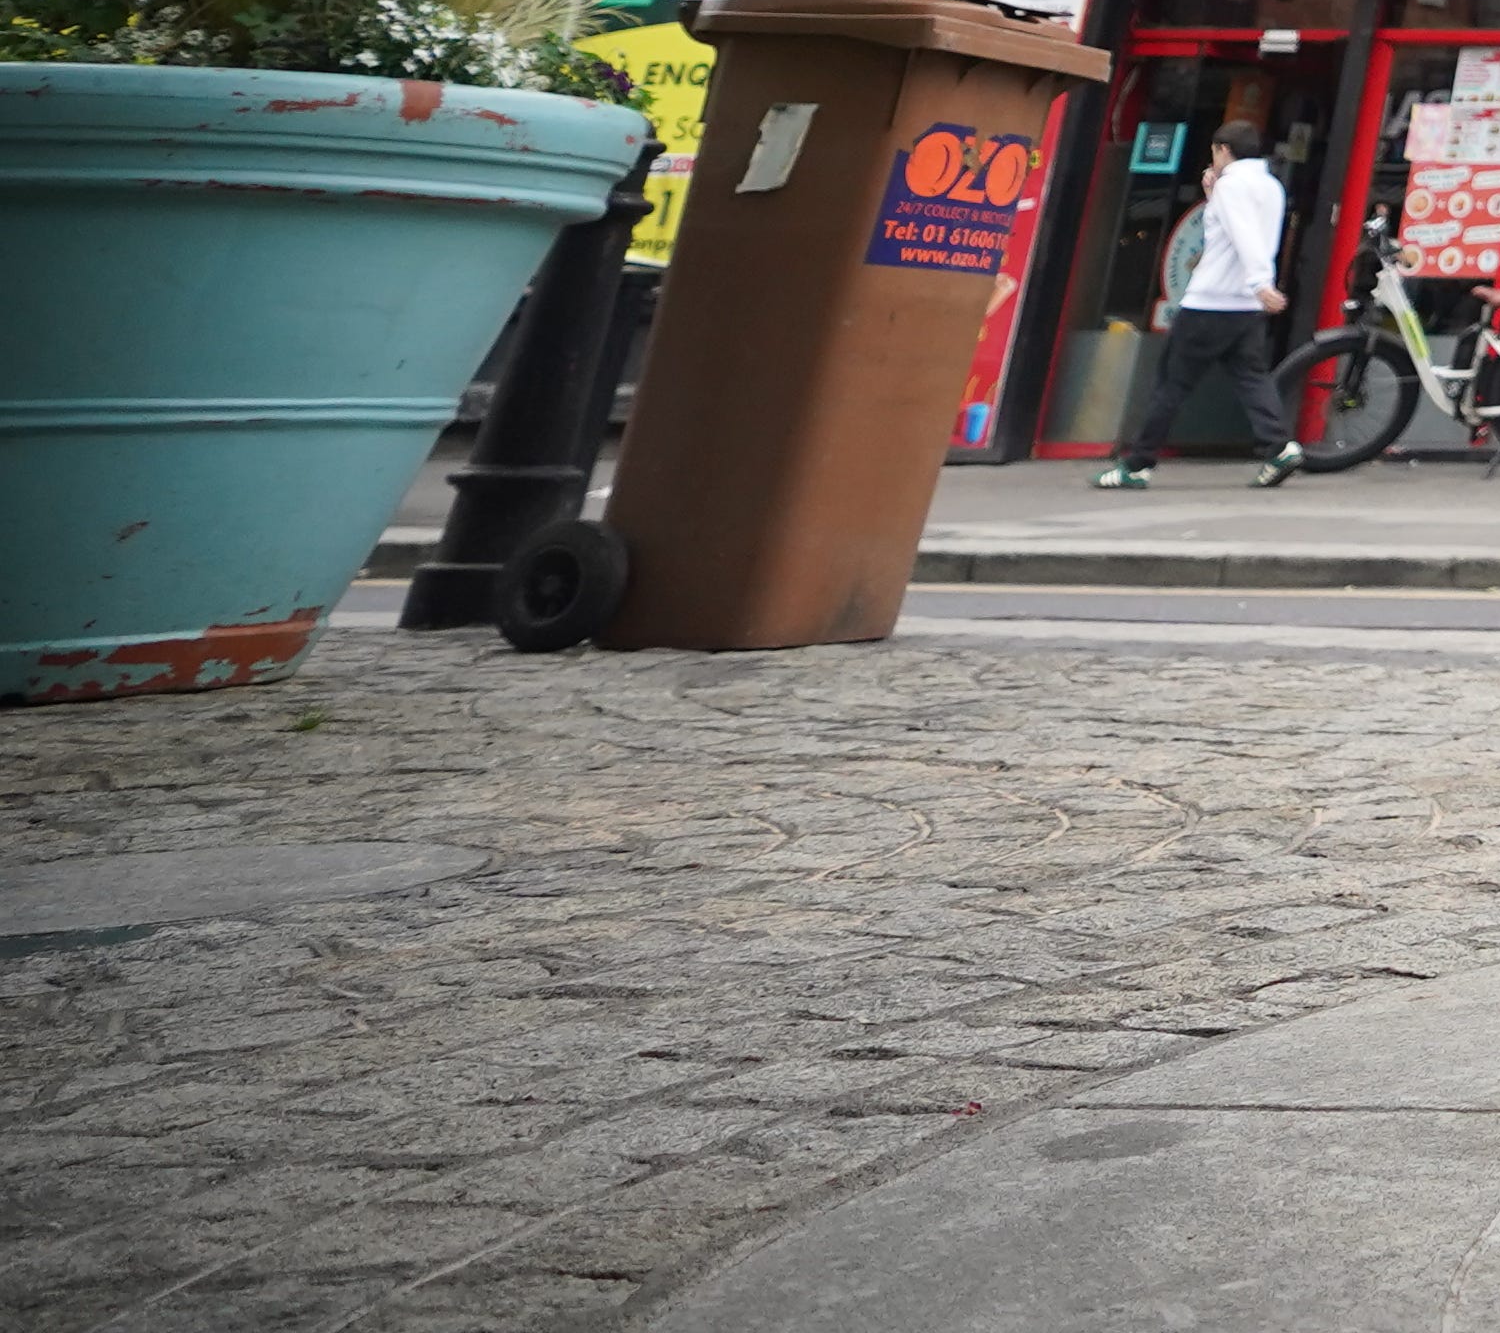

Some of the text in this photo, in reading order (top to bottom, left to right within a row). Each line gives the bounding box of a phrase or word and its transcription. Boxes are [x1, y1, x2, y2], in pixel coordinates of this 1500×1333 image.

[884, 219, 918, 241] Tel:
[922, 223, 946, 243] 01
[901, 247, 992, 270] www.ozo.ie
